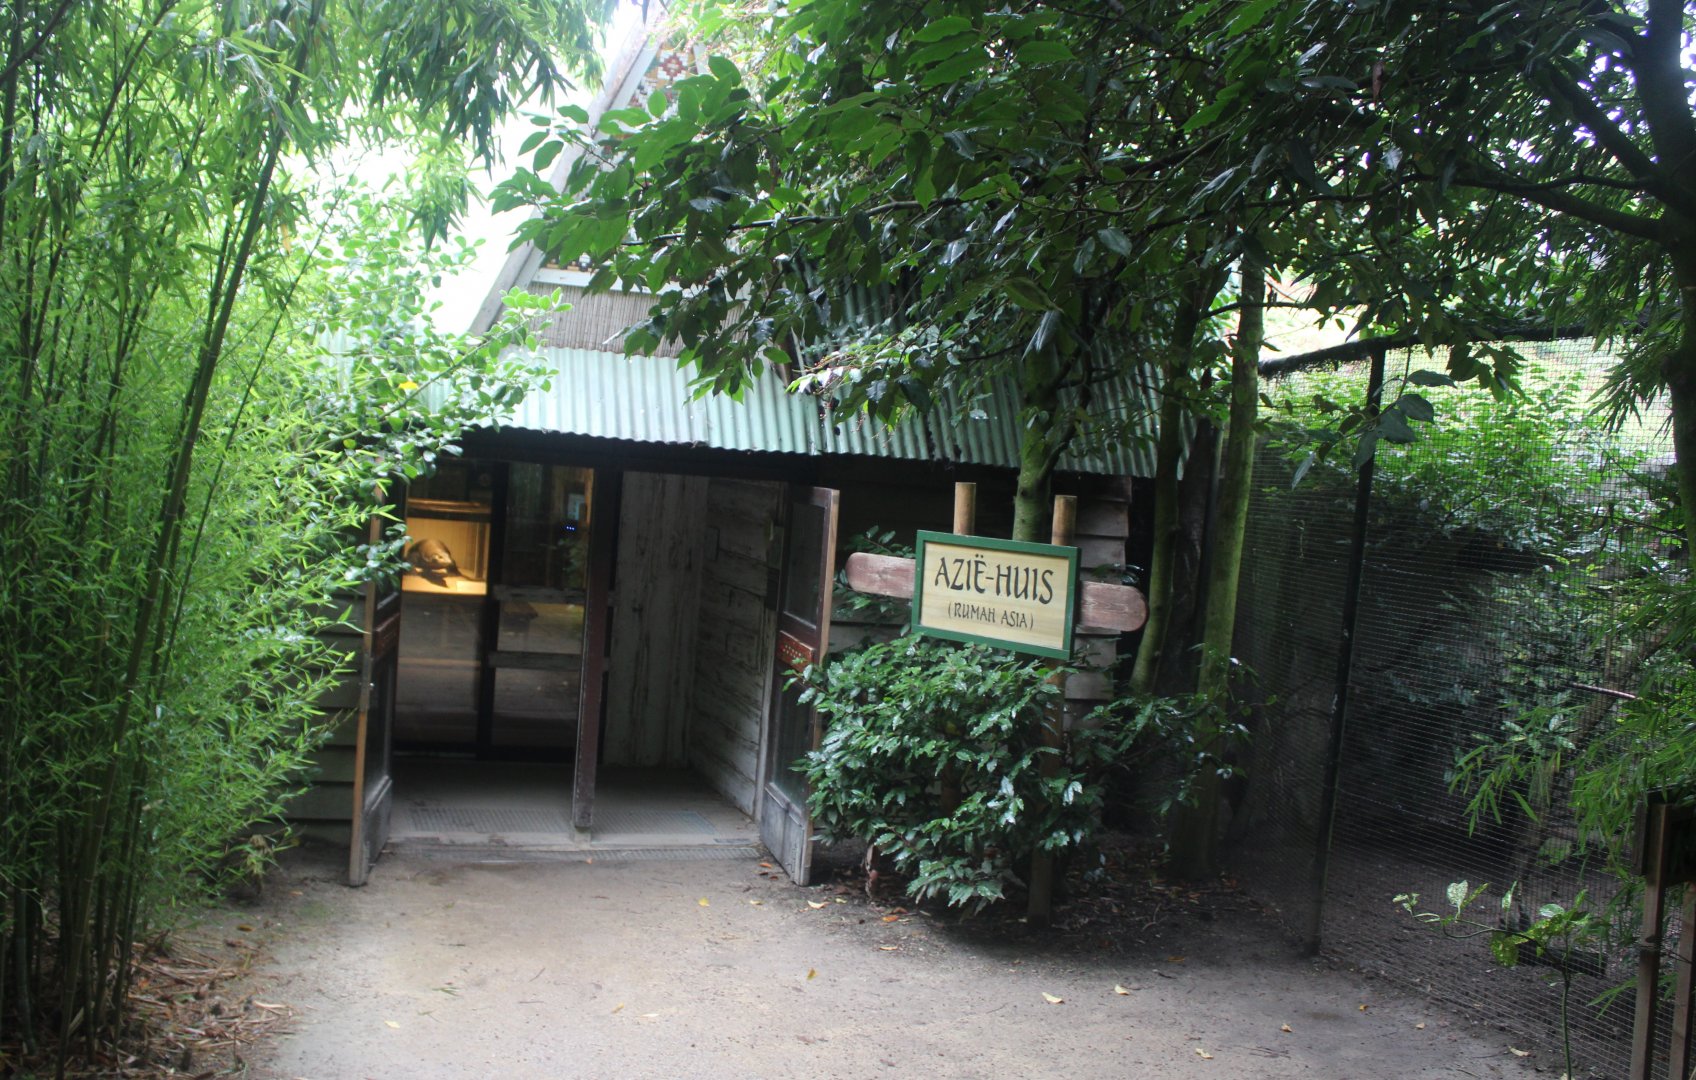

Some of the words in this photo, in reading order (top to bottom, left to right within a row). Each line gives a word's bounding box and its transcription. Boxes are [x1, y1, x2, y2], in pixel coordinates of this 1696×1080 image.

[934, 553, 1054, 604] AZIË-HUIS
[948, 602, 996, 624] (RUMAH
[1000, 610, 1034, 631] ASIA)
